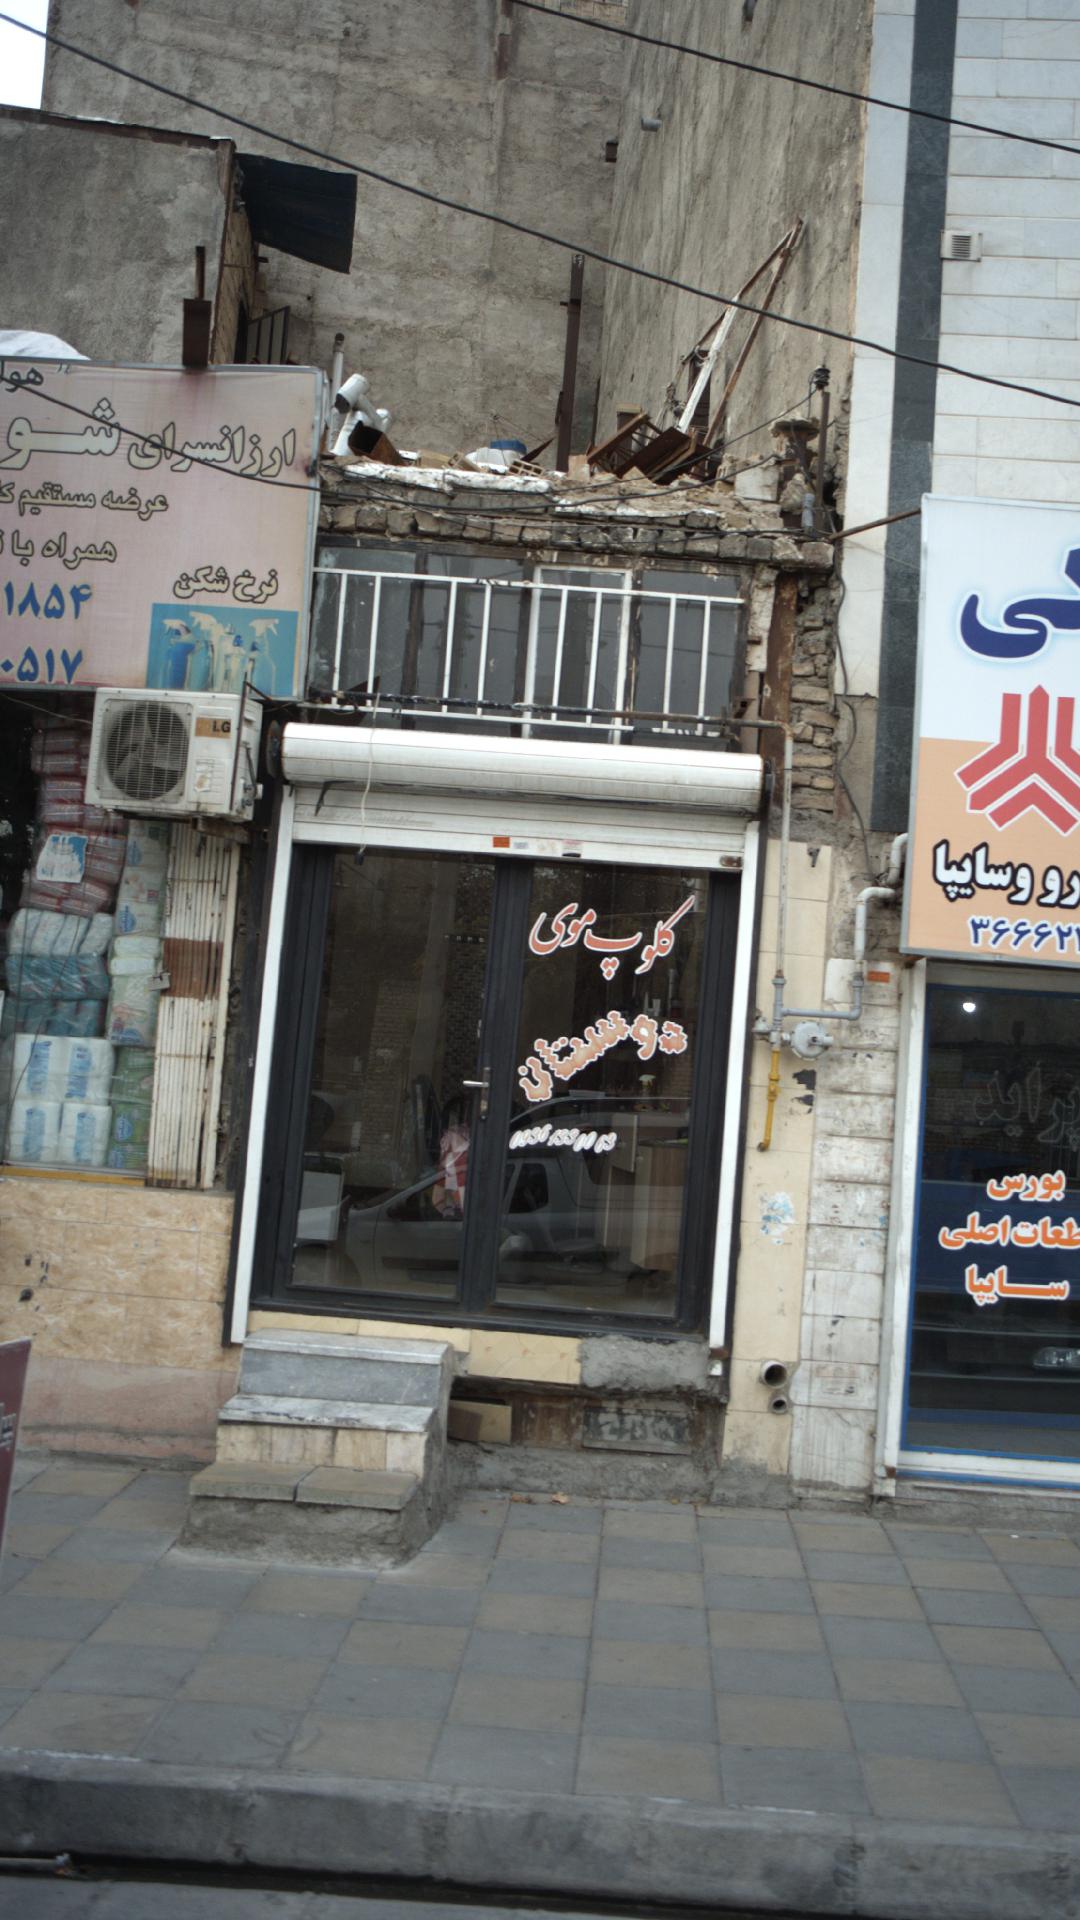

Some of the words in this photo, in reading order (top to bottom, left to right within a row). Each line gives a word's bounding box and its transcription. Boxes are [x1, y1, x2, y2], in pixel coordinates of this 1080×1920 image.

[18, 482, 97, 516] مستقیم
[101, 488, 169, 521] عرضه
[12, 530, 34, 566] با
[42, 532, 117, 570] همراه
[173, 565, 230, 599] شکن
[213, 720, 231, 733] LG
[518, 1010, 687, 1101] دوستان
[987, 1170, 1066, 1201] بورس
[938, 1211, 1011, 1250] اصلی
[965, 1263, 1070, 1306] سایپا
